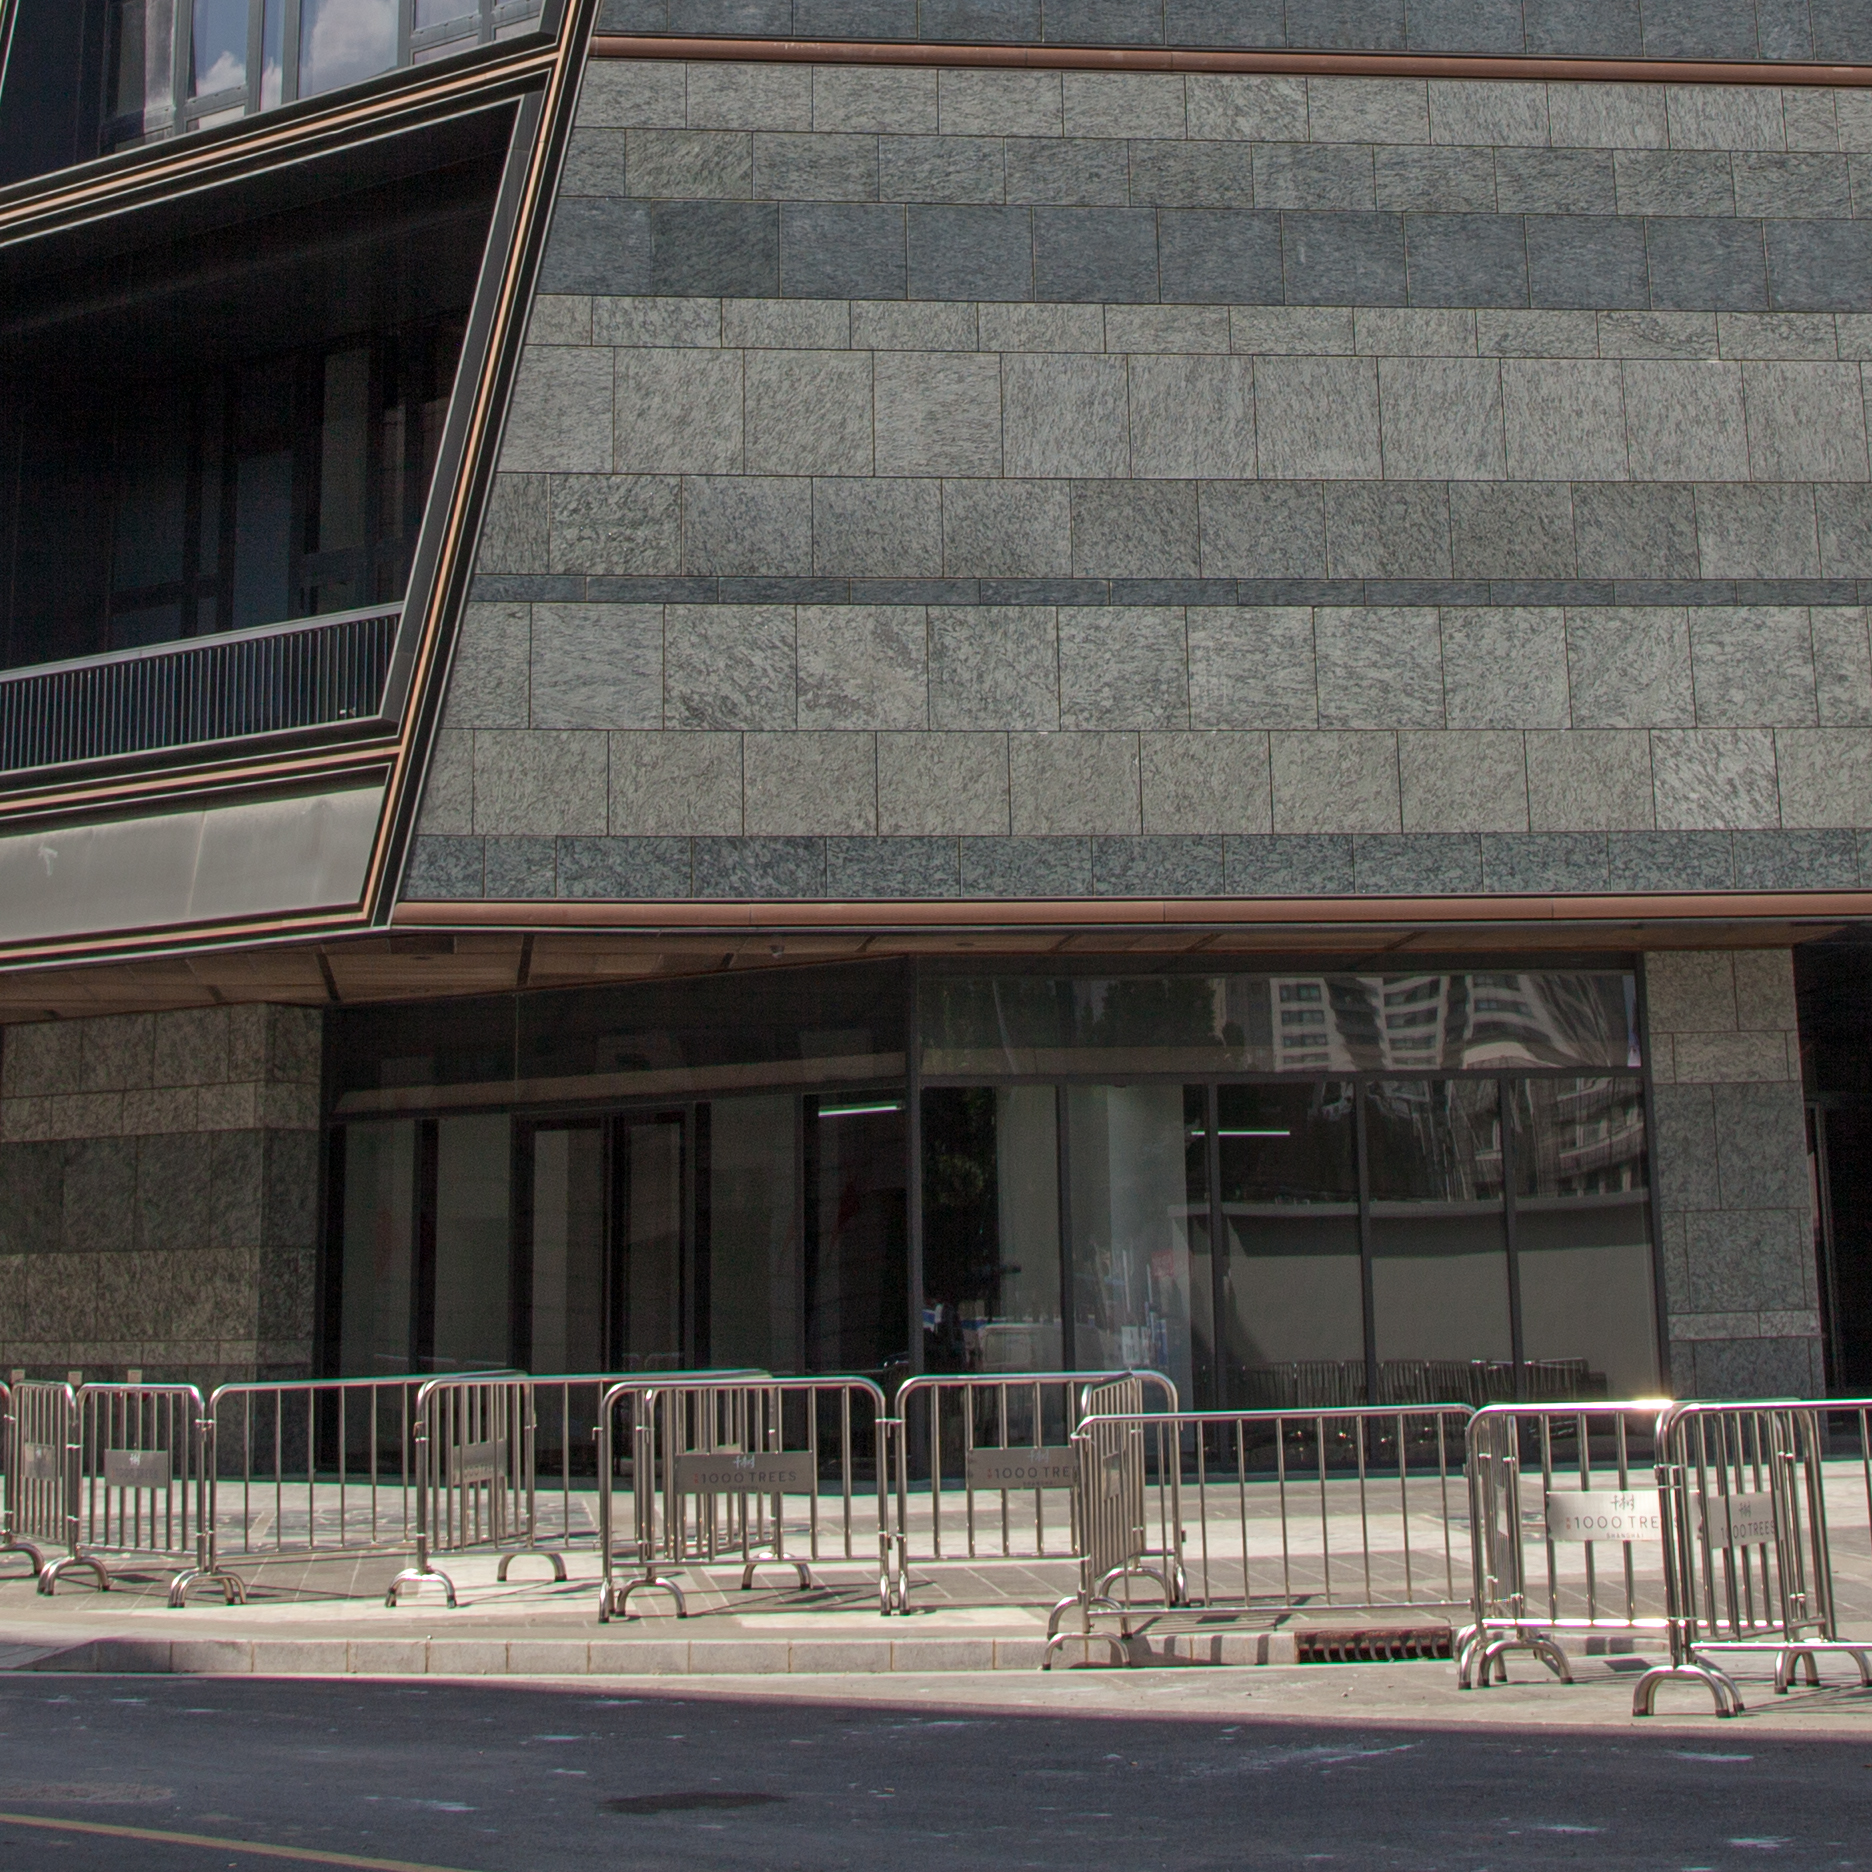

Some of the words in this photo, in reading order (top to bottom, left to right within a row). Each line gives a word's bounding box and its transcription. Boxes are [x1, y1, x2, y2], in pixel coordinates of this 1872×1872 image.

[701, 1471, 744, 1484] 1000
[749, 1471, 797, 1483] TREES
[994, 1466, 1038, 1479] 1000
[1043, 1466, 1077, 1478] TRE
[1574, 1515, 1623, 1529] 1000
[1627, 1516, 1678, 1529] TRE
[1720, 1523, 1747, 1541] 100
